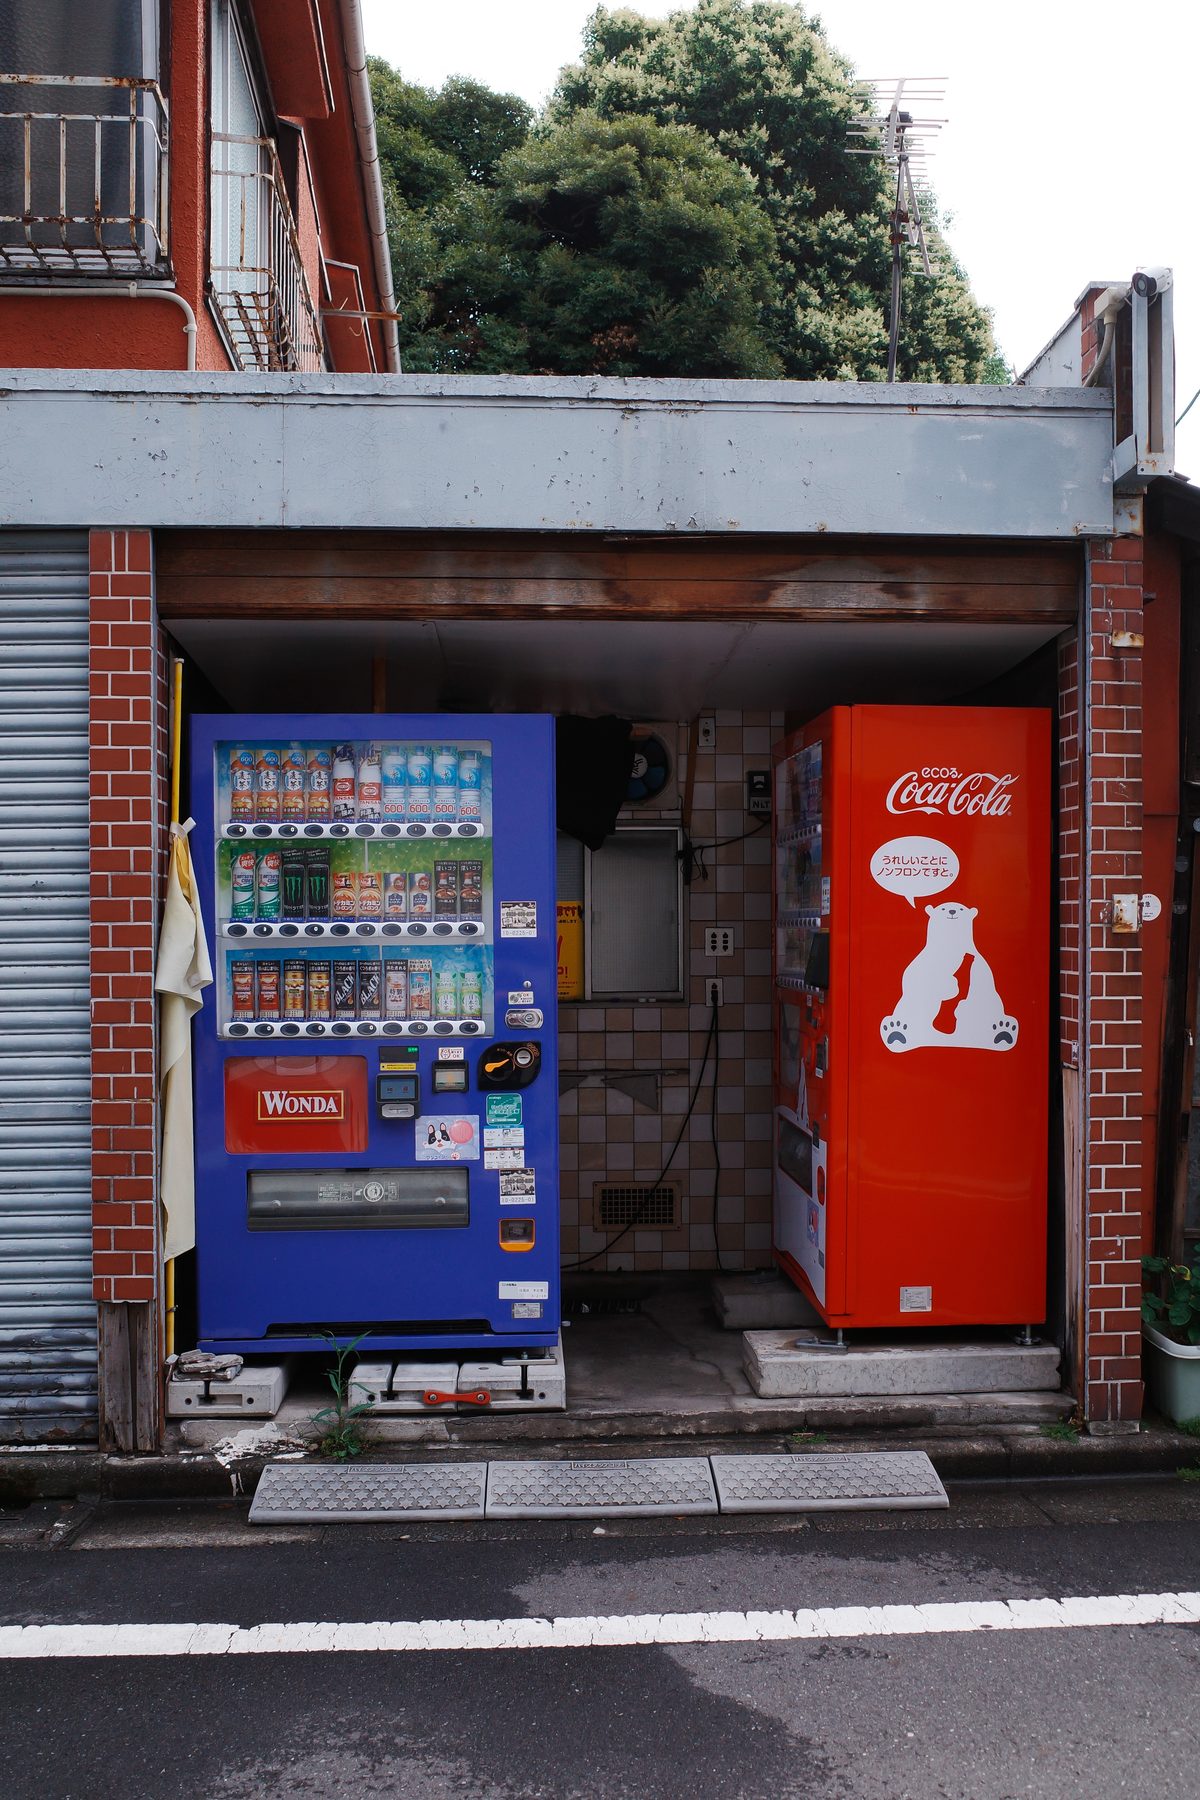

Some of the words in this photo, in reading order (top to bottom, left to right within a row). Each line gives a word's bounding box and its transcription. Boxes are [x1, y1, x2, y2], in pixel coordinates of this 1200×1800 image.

[886, 772, 1020, 816] Coca-Cola
[384, 804, 403, 813] 600
[410, 804, 428, 813] 600
[435, 804, 454, 813] 600
[460, 806, 478, 816] 600
[882, 855, 948, 865] うれしいことに
[877, 867, 953, 877] ノンフロンですと。
[335, 973, 355, 1005] BLACK
[360, 973, 380, 1005] BLACK
[261, 1091, 338, 1115] WONDA
